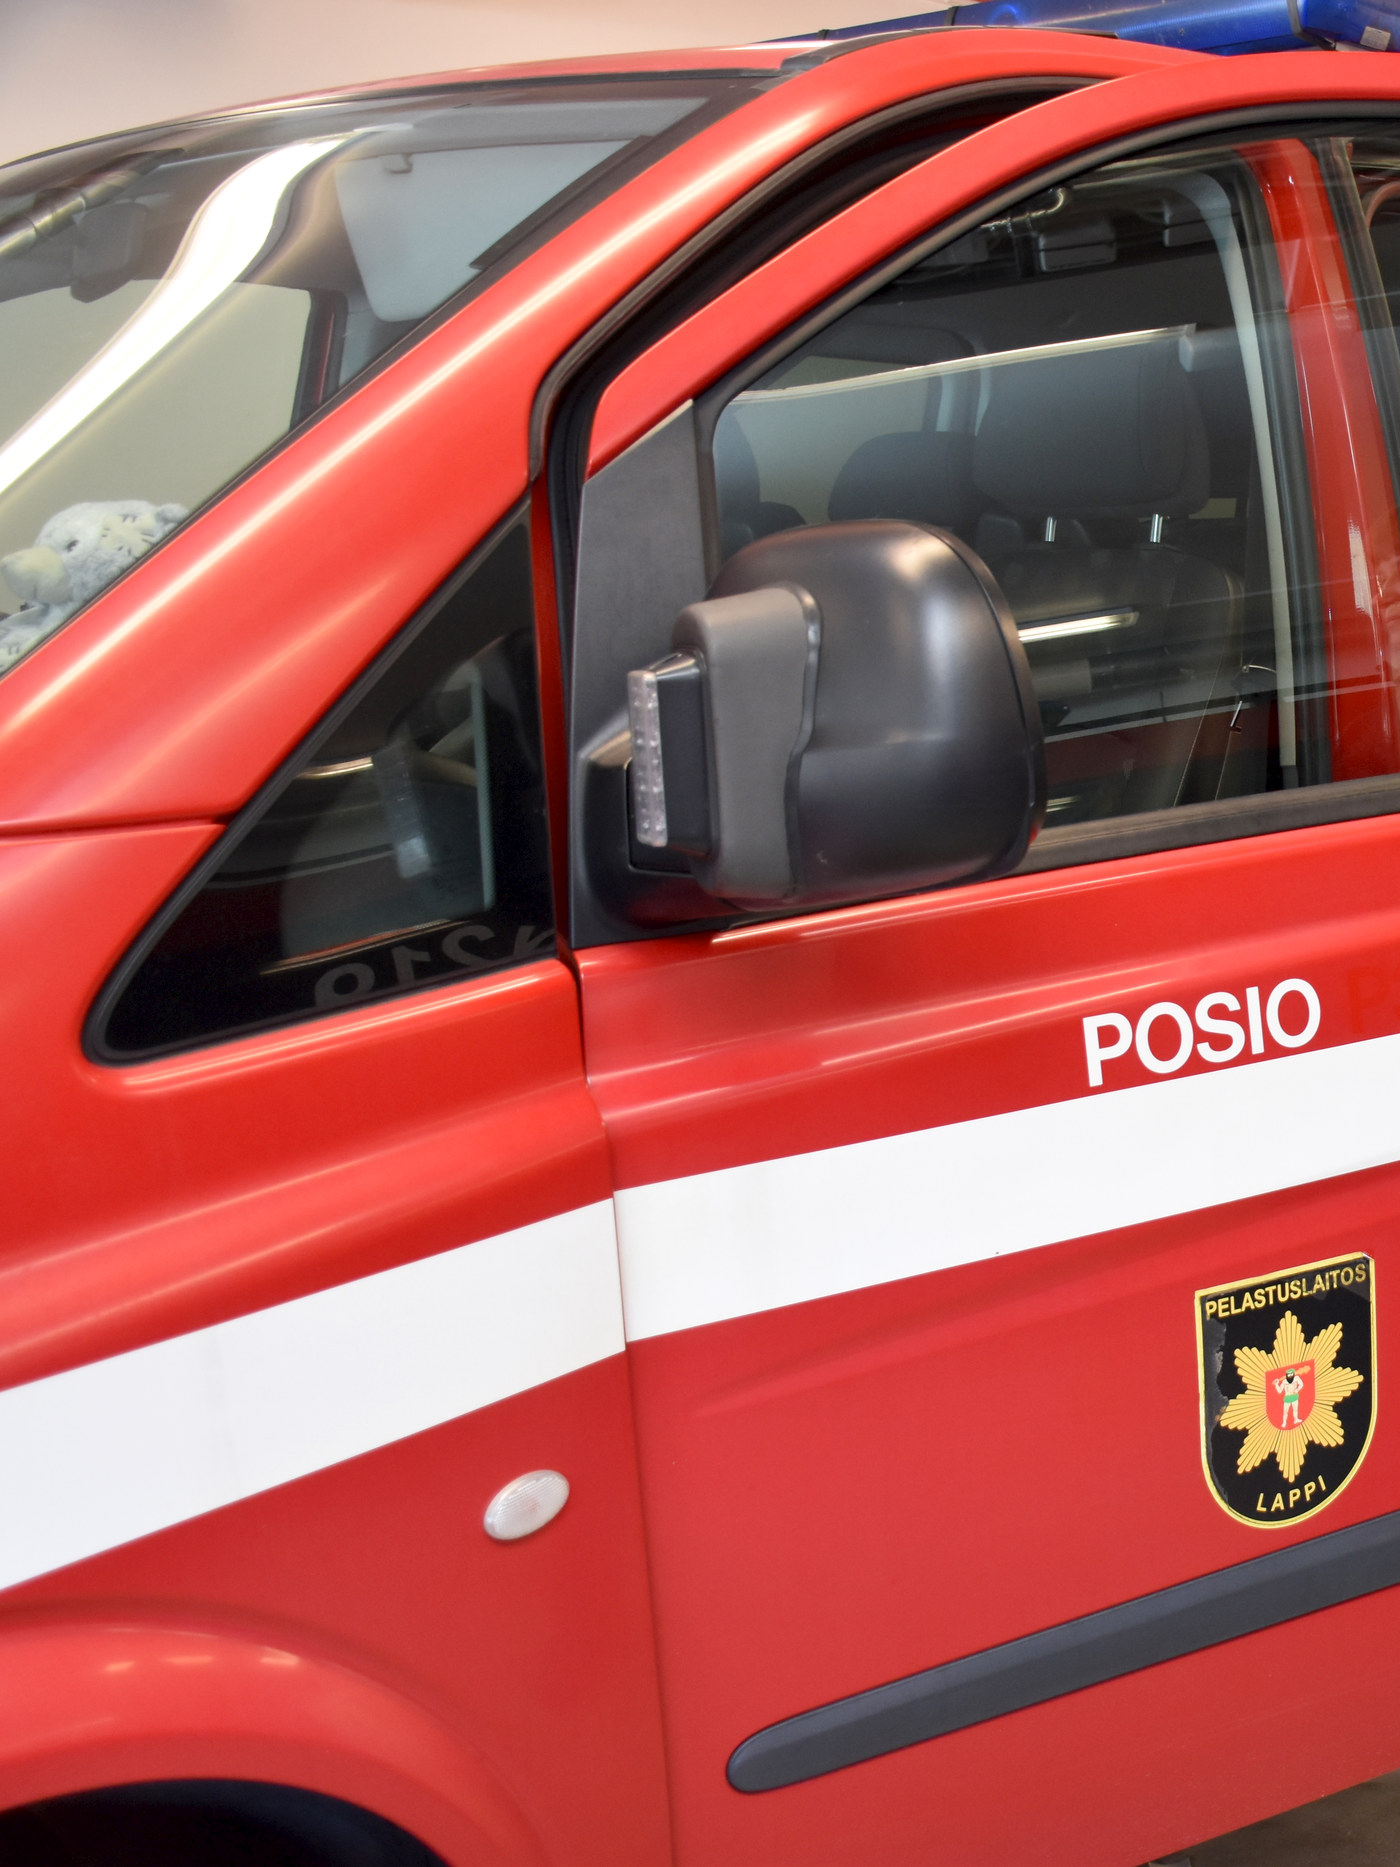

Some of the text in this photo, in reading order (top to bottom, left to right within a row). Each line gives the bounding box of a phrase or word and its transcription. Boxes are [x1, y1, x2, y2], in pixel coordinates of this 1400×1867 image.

[1083, 978, 1321, 1087] POSIO
[1205, 1263, 1367, 1320] PELASTUSLAITOS
[1256, 1475, 1327, 1512] LAPPI
